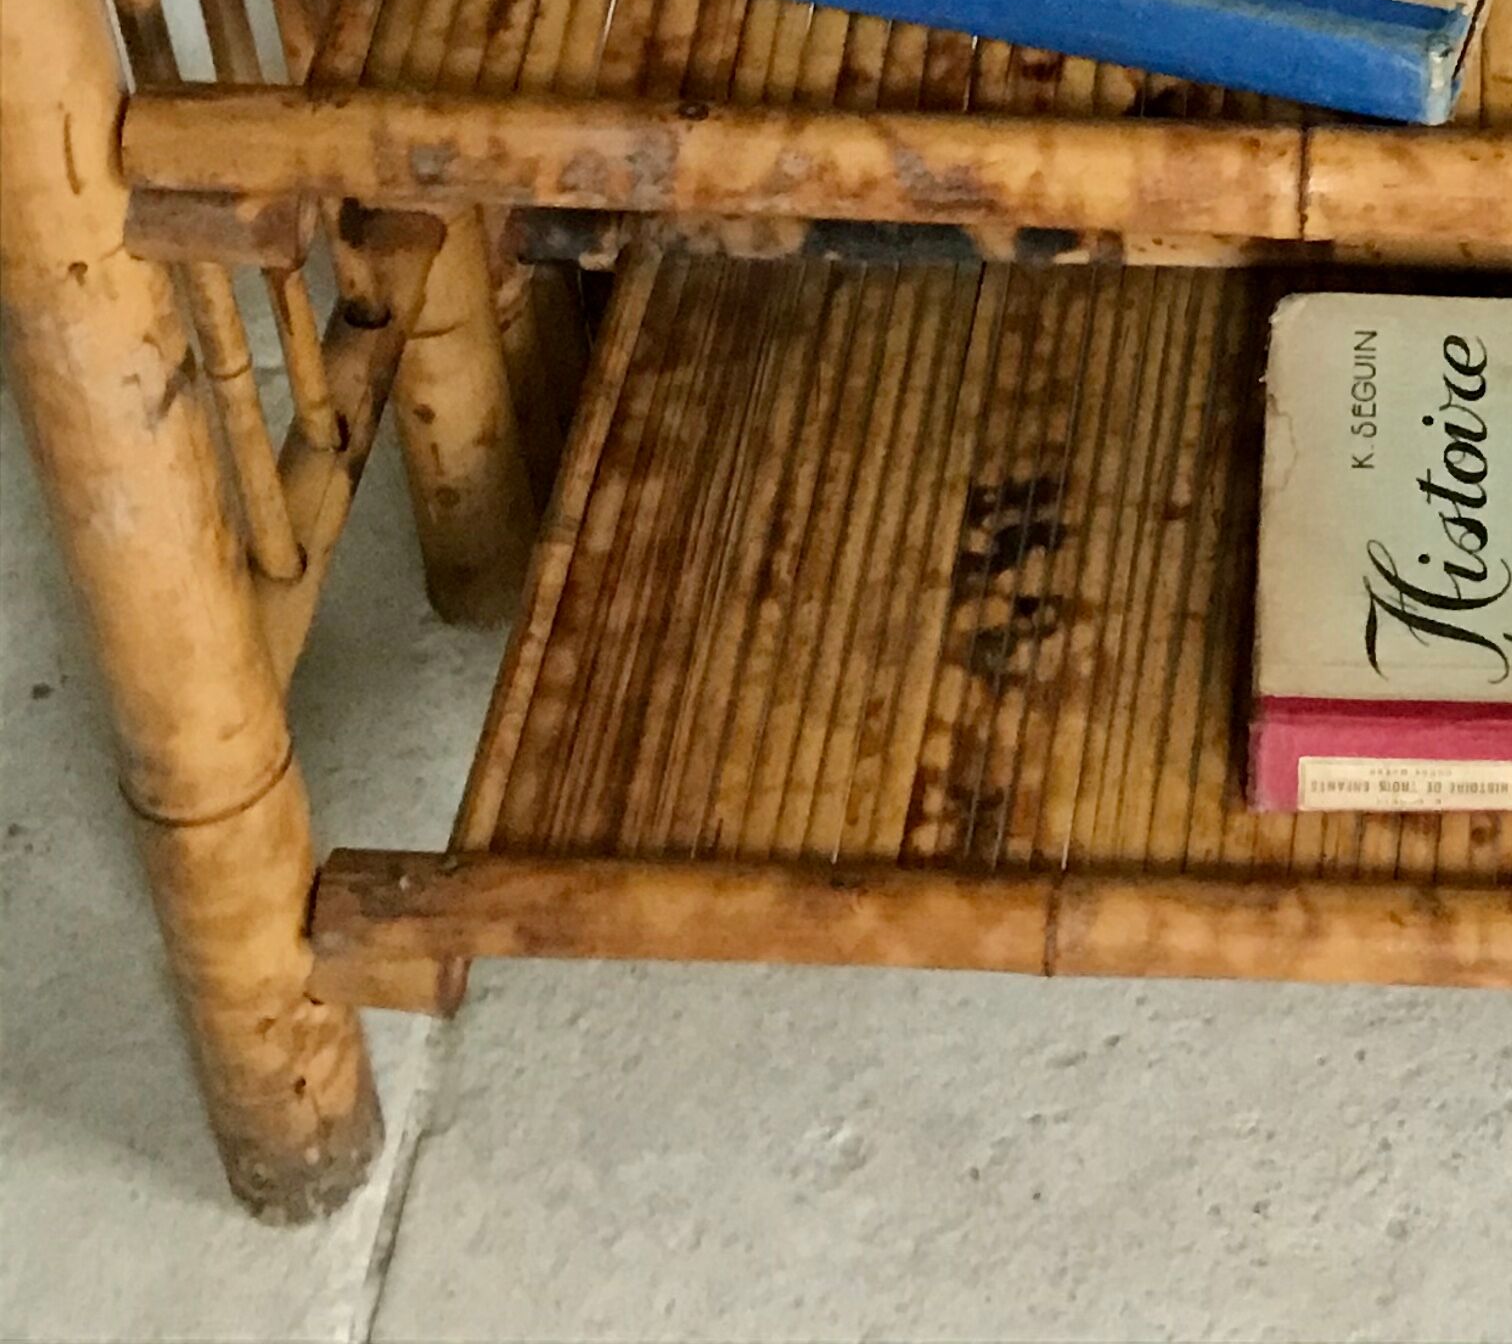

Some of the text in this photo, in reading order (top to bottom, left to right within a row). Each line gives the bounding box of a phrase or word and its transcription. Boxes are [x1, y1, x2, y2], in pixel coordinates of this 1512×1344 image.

[1350, 329, 1378, 470] K. SEGUIN
[1363, 334, 1512, 686] Histoire
